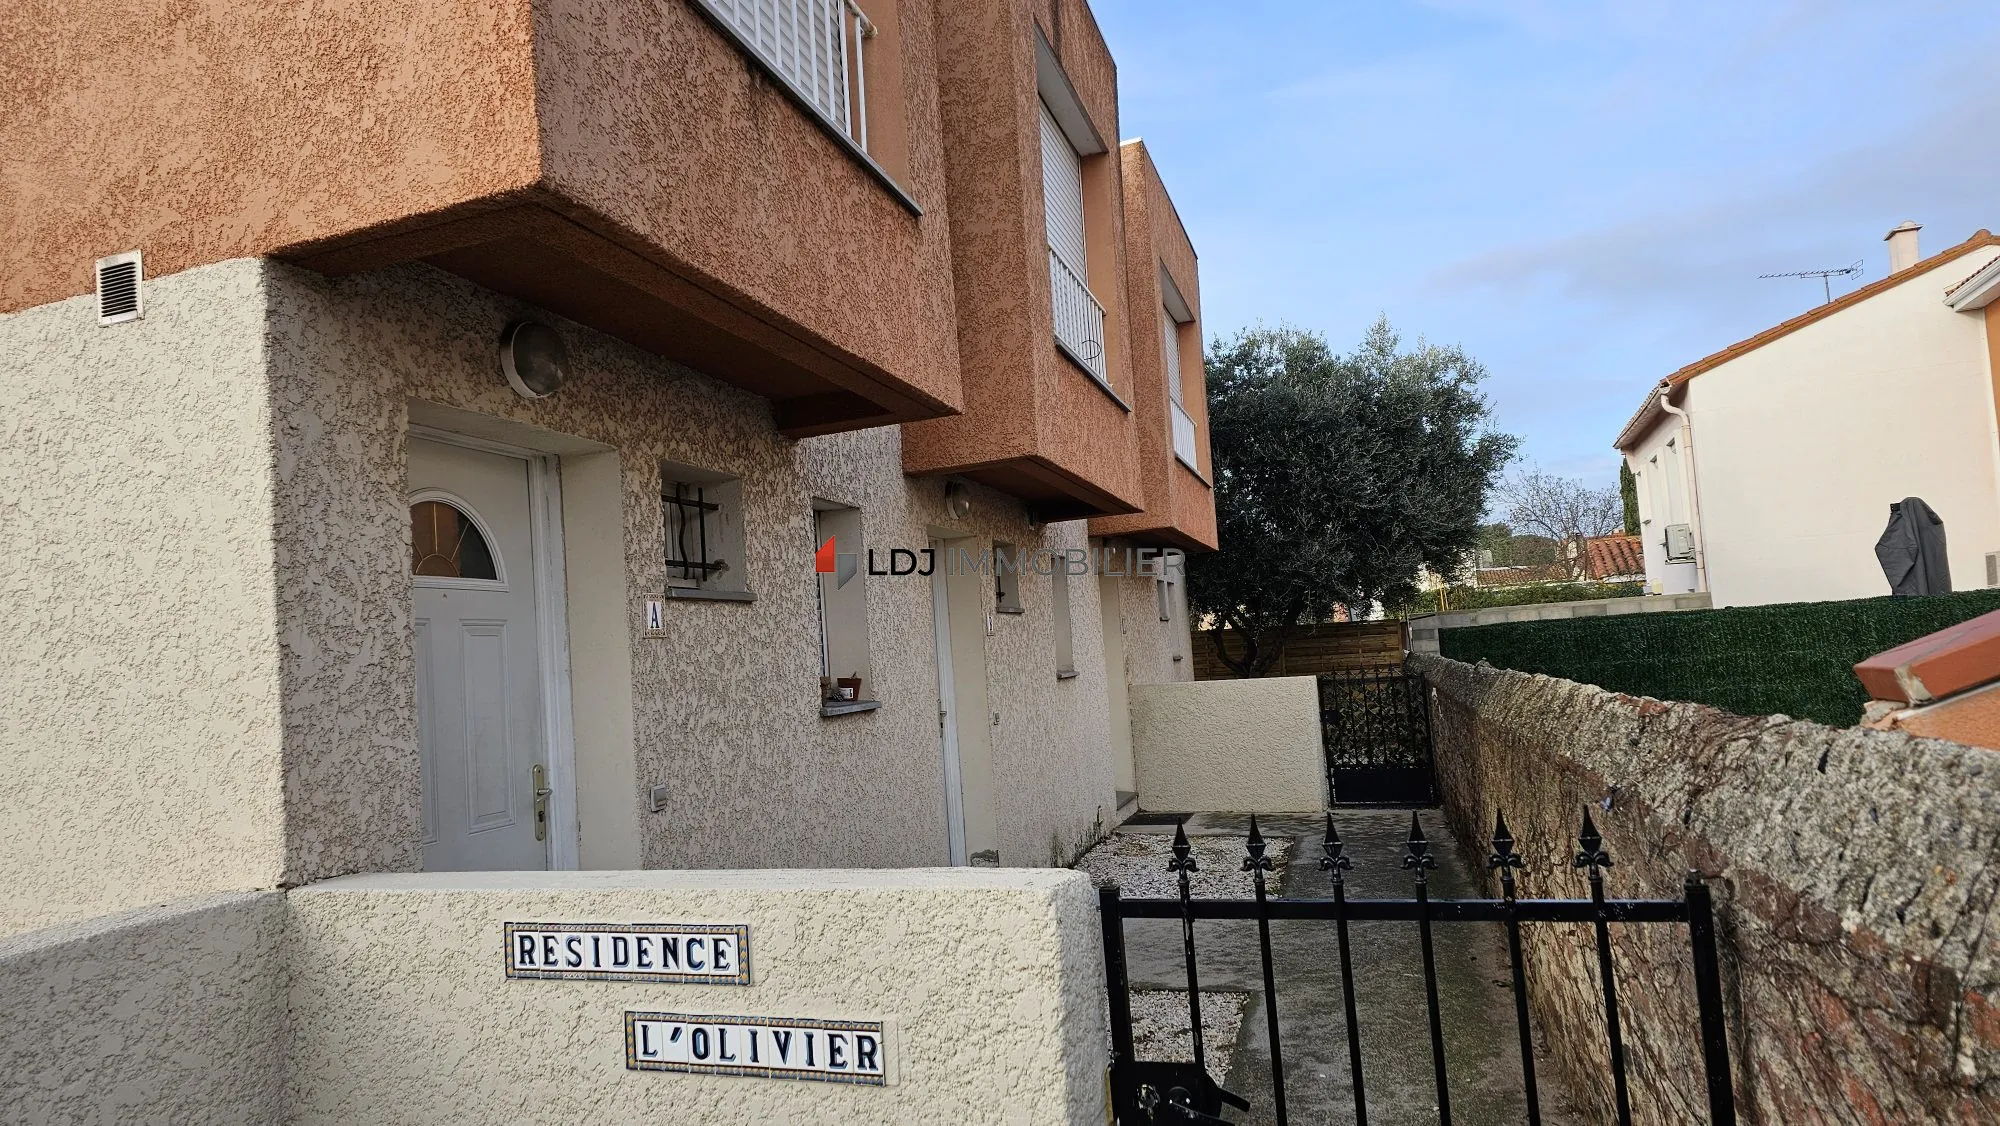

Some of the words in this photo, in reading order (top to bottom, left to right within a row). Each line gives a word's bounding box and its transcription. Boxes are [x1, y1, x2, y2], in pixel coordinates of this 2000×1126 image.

[650, 602, 660, 628] A
[518, 934, 731, 971] RESIDENCE
[641, 1024, 880, 1071] L'OLIVIER
